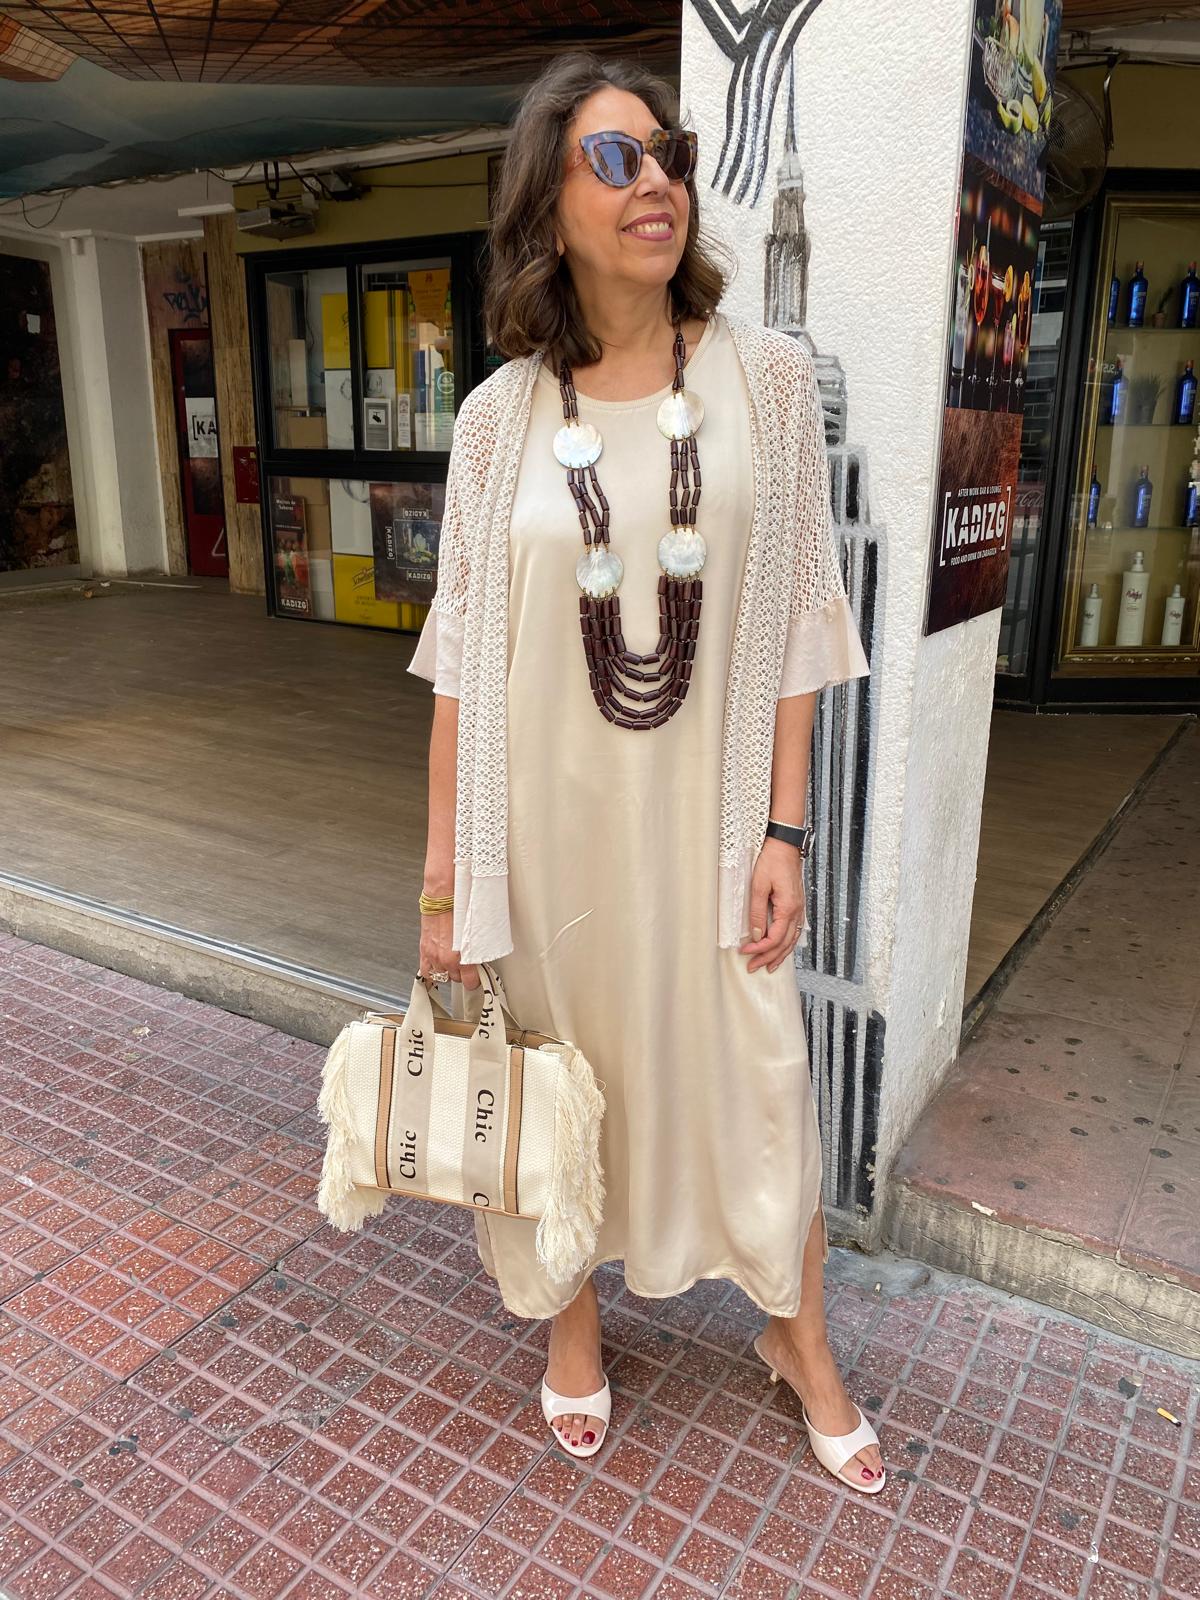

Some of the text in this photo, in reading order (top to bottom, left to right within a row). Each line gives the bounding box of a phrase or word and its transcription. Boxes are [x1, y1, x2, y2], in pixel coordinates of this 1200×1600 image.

[478, 989, 495, 1039] Chic
[407, 1029, 424, 1077] Chic
[475, 1089, 495, 1143] Chic
[399, 1130, 417, 1179] Chic
